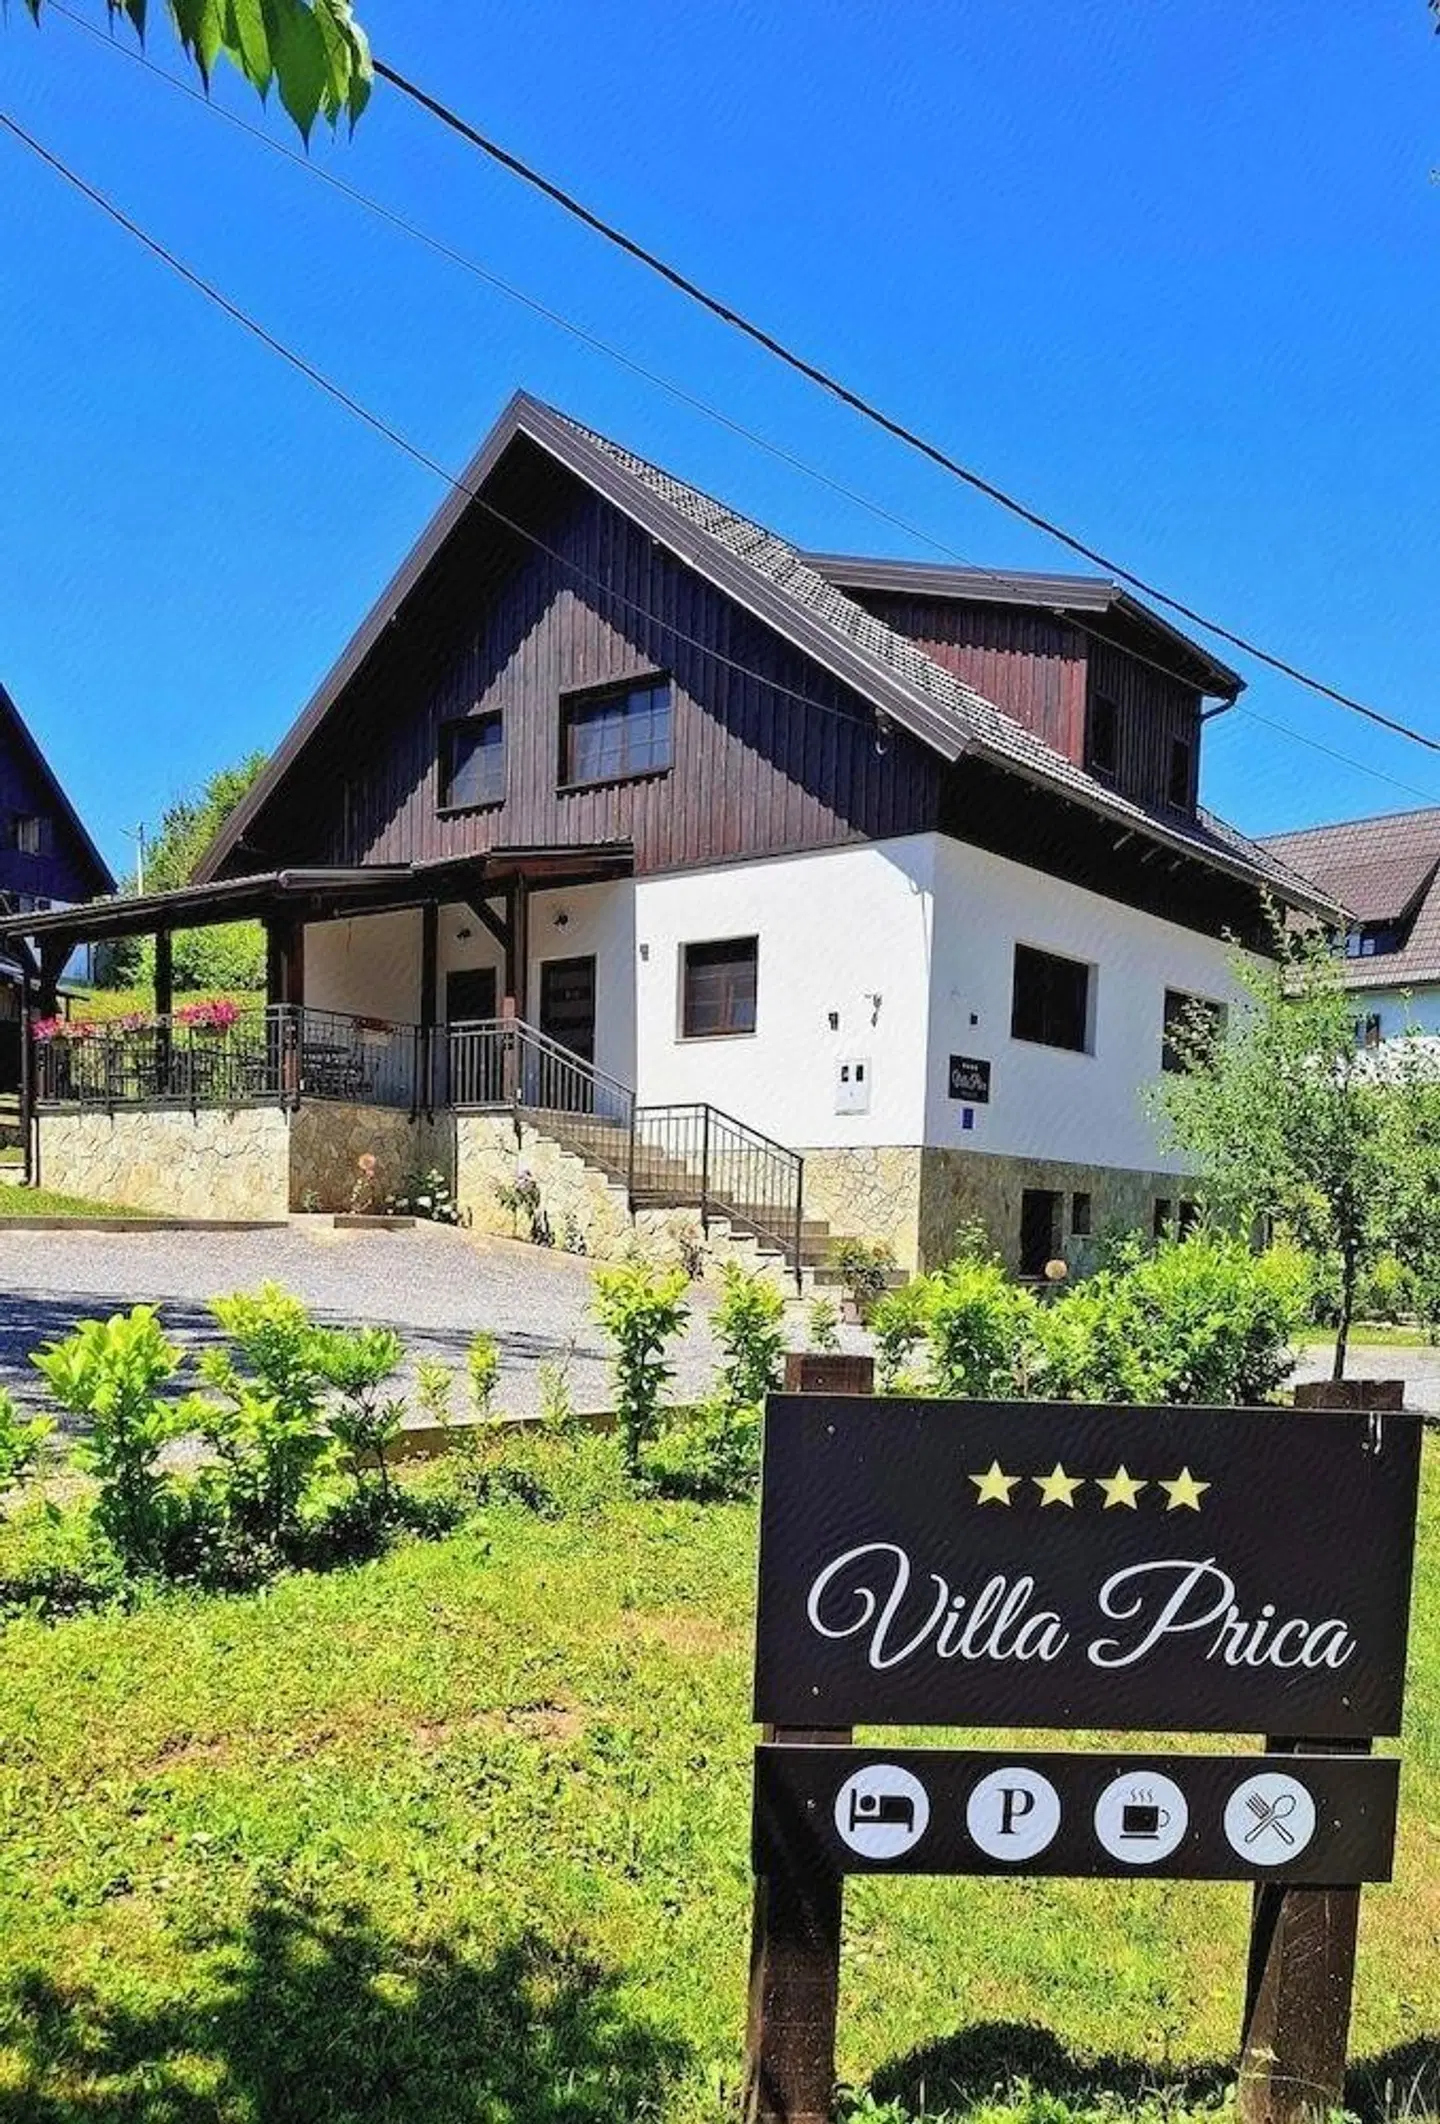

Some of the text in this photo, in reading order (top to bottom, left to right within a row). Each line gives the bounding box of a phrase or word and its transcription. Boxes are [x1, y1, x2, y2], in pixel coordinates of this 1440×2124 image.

[807, 1542, 1356, 1669] Villa Prica
[996, 1787, 1035, 1835] P
